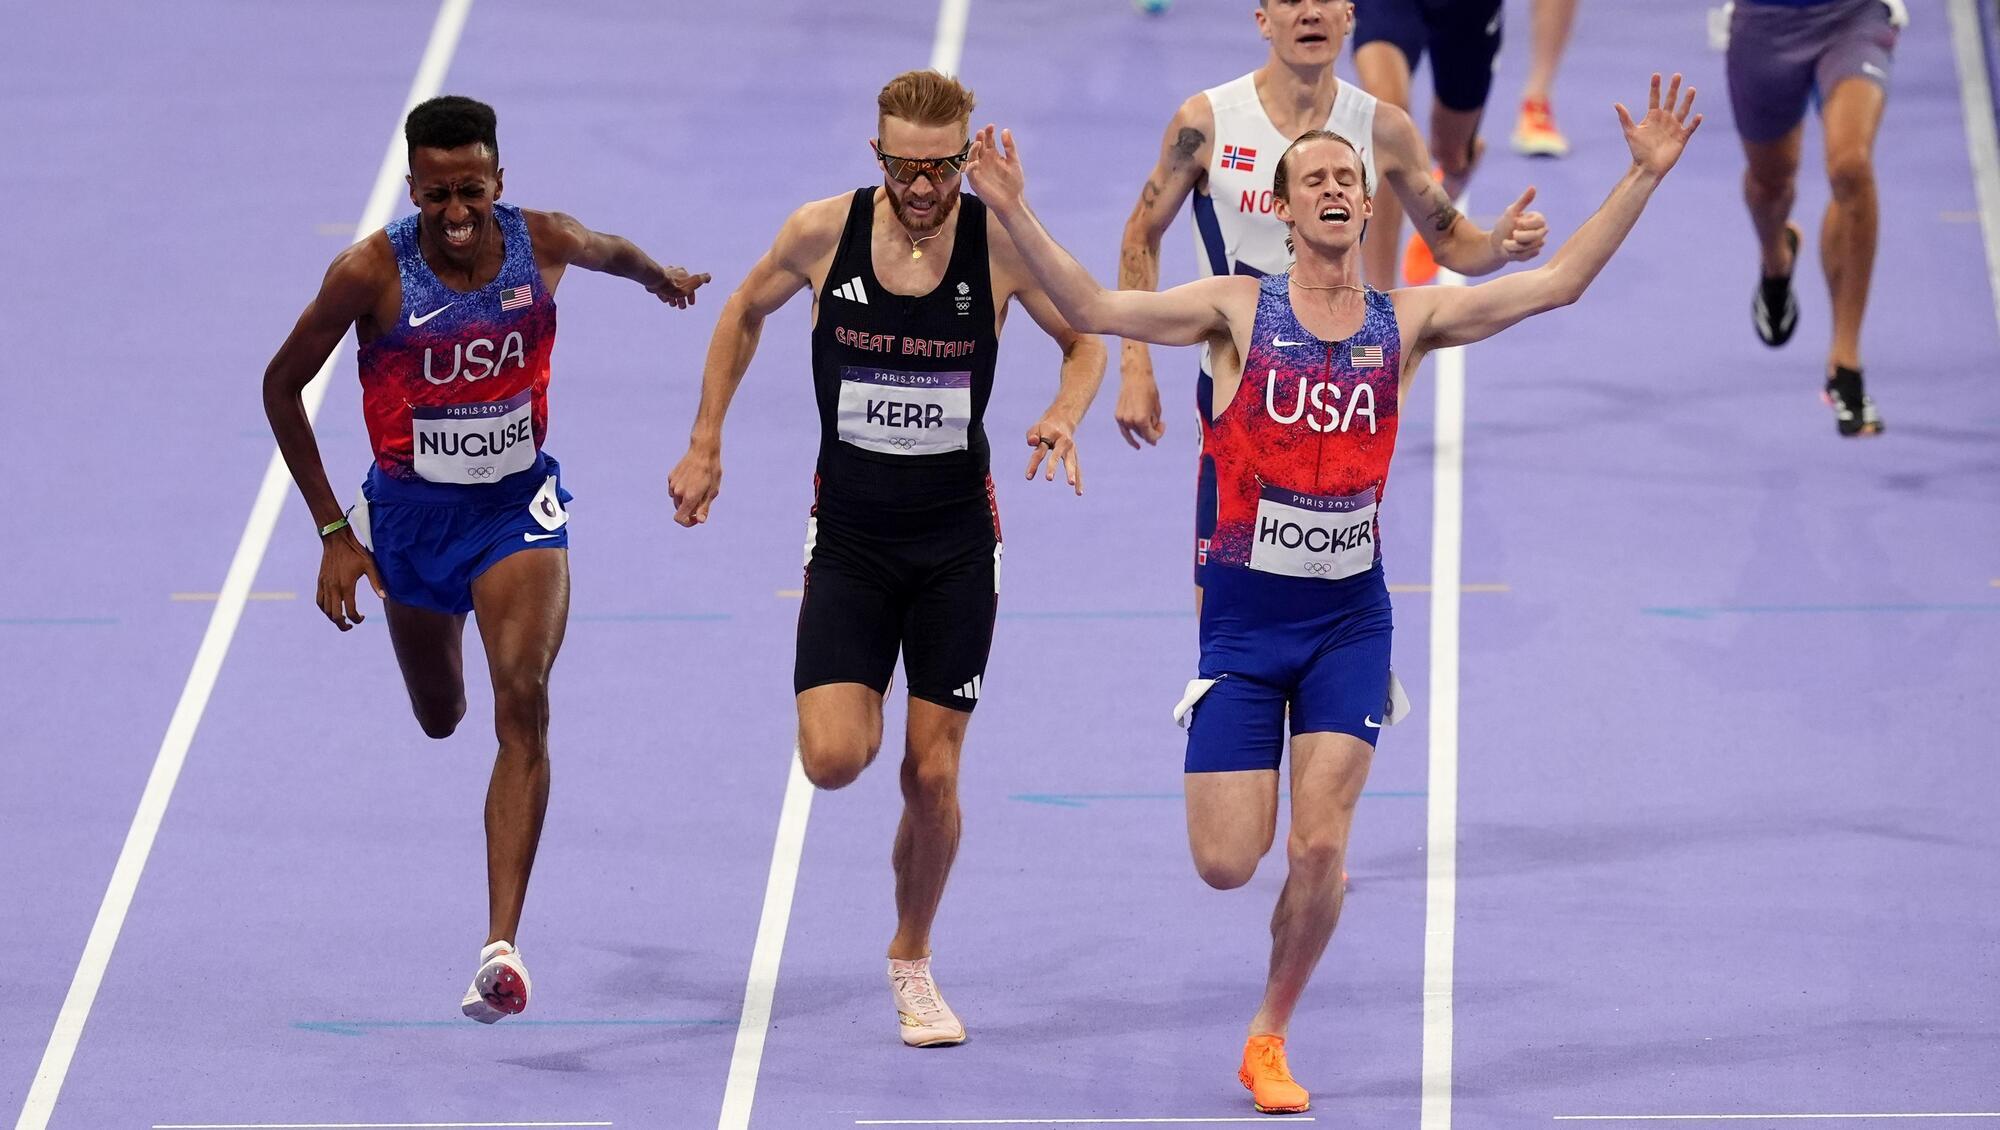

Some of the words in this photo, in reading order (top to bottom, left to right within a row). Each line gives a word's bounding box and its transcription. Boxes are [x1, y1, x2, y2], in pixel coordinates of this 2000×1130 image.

[423, 331, 525, 385] USA
[835, 326, 895, 353] GREAT
[902, 337, 976, 359] BRITAIN
[874, 372, 906, 384] PARIS
[909, 376, 939, 385] 2024
[447, 406, 479, 416] PARIS
[482, 404, 509, 414] 2024
[866, 399, 943, 429] KERR
[1266, 369, 1377, 435] USA
[419, 416, 530, 457] NUGUSE
[1293, 495, 1324, 509] PARIS
[1328, 501, 1356, 509] 2024
[1259, 516, 1371, 554] HOCKER
